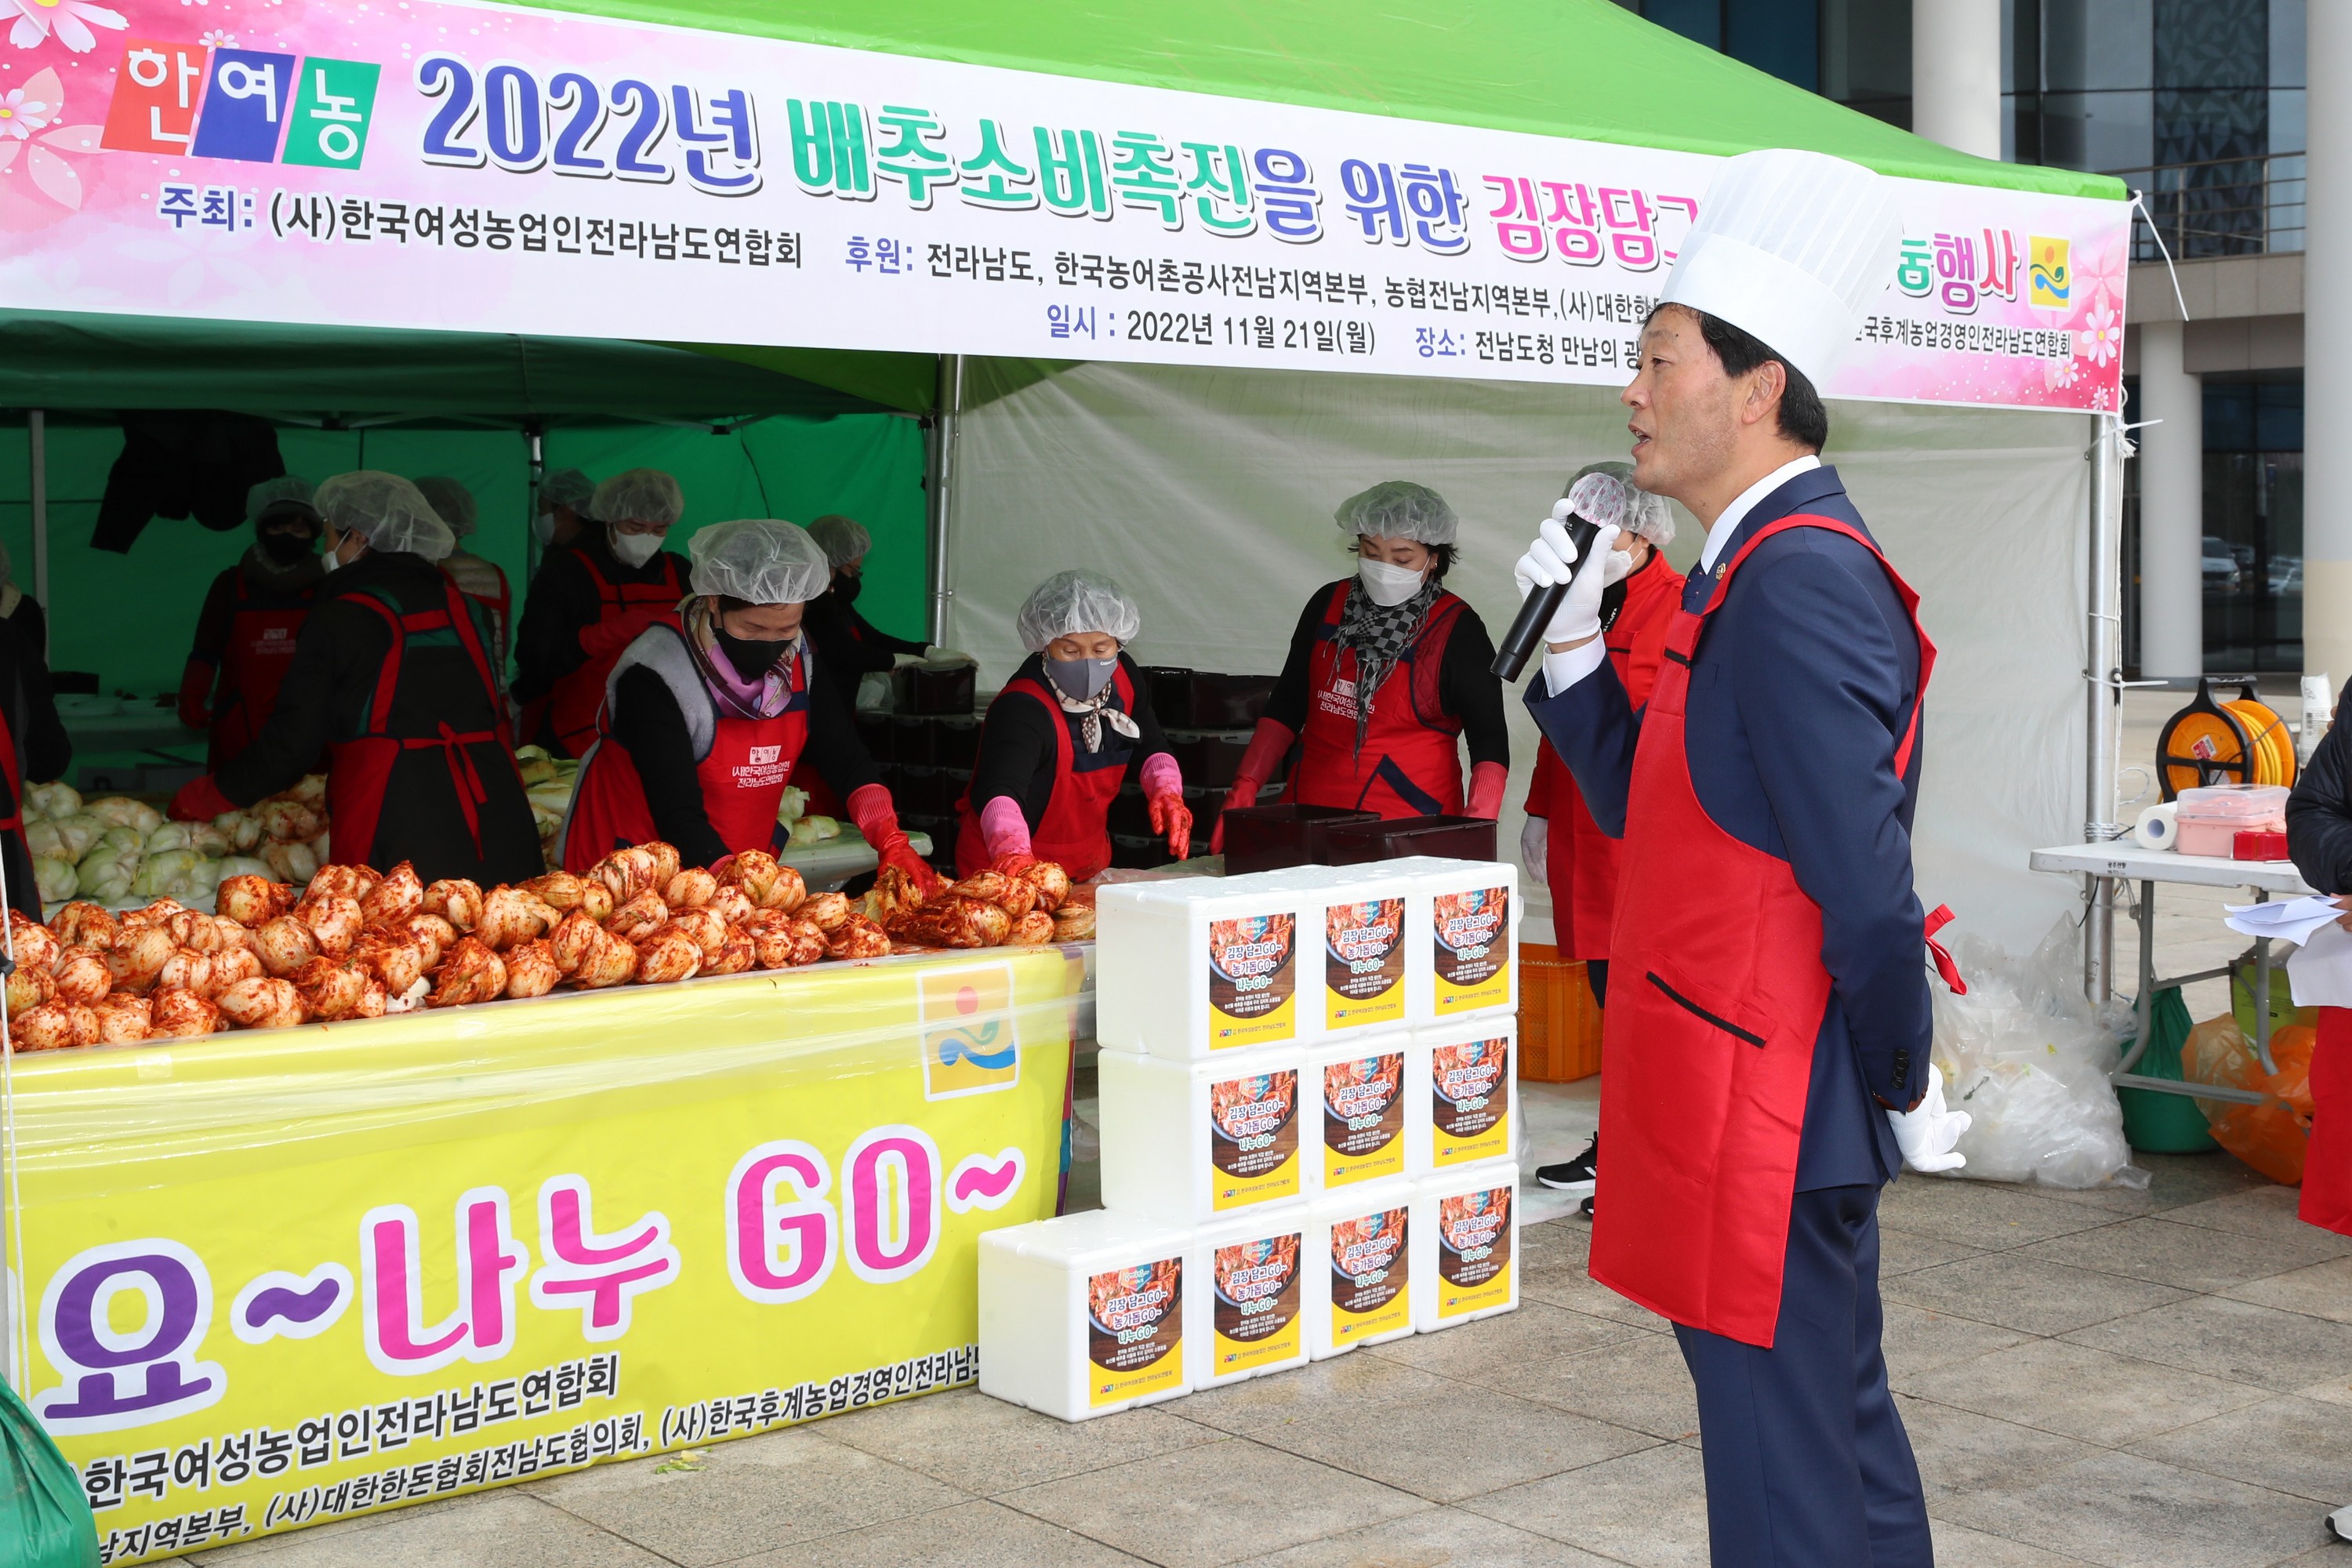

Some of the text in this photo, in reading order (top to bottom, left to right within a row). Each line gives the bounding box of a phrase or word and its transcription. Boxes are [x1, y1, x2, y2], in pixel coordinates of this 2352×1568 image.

[125, 47, 362, 162] 한여농
[417, 55, 760, 194] 2022년
[786, 97, 1322, 240] 배추소비촉진을
[1341, 157, 1468, 252] 위한
[1896, 227, 2020, 310] 눔행사
[159, 187, 802, 268] 주최: (사)한국여성농업인전라남도연합회
[844, 234, 913, 276] 후원:
[927, 242, 1044, 288] 전라남도,
[1053, 250, 1377, 309] 한국농어촌공사전남지역본부,
[1127, 309, 1214, 347] 2022년
[1221, 318, 1276, 351] 11월
[1283, 320, 1376, 357] 21일(월)
[1415, 325, 1465, 360] 장소:
[1475, 332, 1554, 367] 전남도청
[1561, 336, 1617, 368] 만남의
[1855, 315, 2071, 359] 국후계농업경영인전라남도연합회
[1450, 918, 1463, 931] 김장
[1343, 930, 1357, 942] 김장
[1228, 946, 1243, 959] 김장
[1449, 1070, 1462, 1083] 김장
[1341, 1087, 1356, 1100] 김장
[1230, 1105, 1246, 1120] 김장
[1455, 1220, 1468, 1232] 김장
[1348, 1244, 1362, 1258] 김장
[1232, 1270, 1248, 1284] 김장
[1109, 1298, 1126, 1312] 김장
[85, 1352, 619, 1510] 한국여성농업인전라남도연합회
[100, 1505, 251, 1565] 남지역본부,
[661, 1344, 978, 1446] (사)한국후계농업경영인전라남
